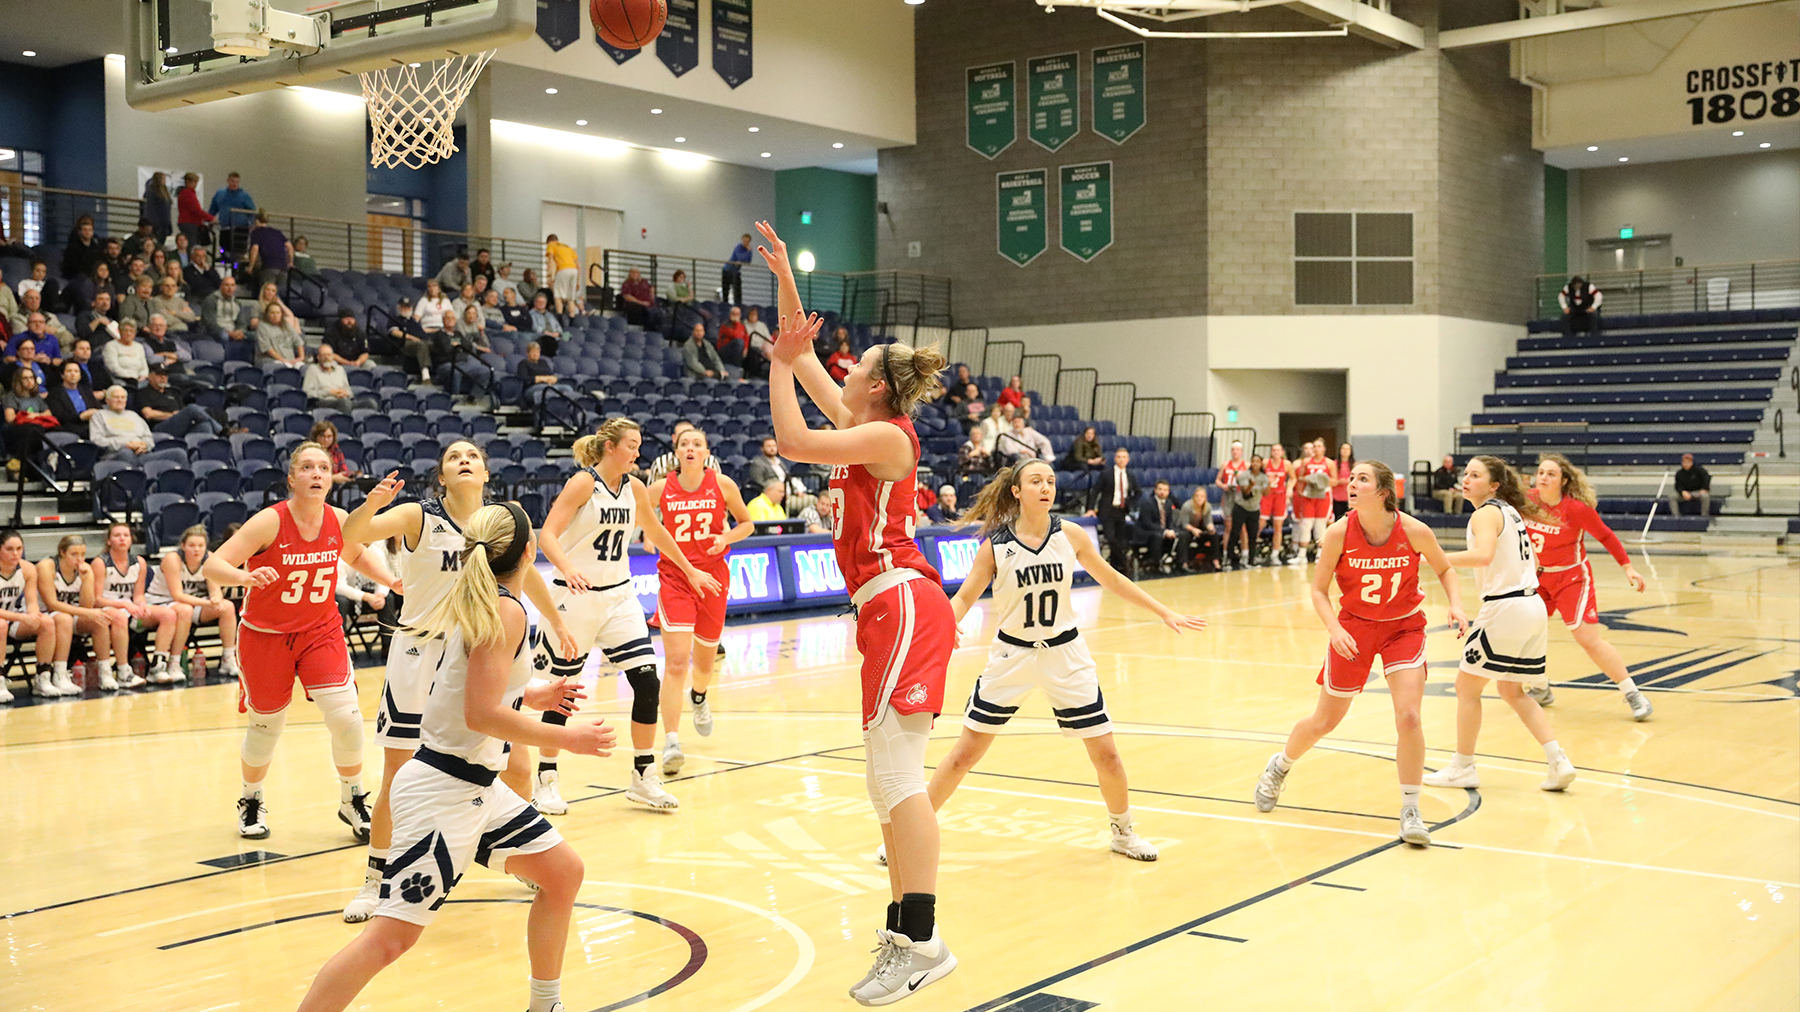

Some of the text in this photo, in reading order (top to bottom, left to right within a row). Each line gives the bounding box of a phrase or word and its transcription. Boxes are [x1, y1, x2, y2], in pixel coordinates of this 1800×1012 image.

[1686, 87, 1800, 125] 1808
[1071, 172, 1100, 182] SOCCER
[667, 499, 717, 511] WILDCATS
[674, 512, 713, 542] 23
[282, 549, 338, 565] WILDCATS
[593, 529, 625, 562] 40
[1015, 563, 1064, 588] MVNU
[1348, 555, 1410, 570] WILDCATS
[281, 566, 335, 604] 35
[1361, 572, 1402, 604] 21
[1023, 589, 1059, 629] 10
